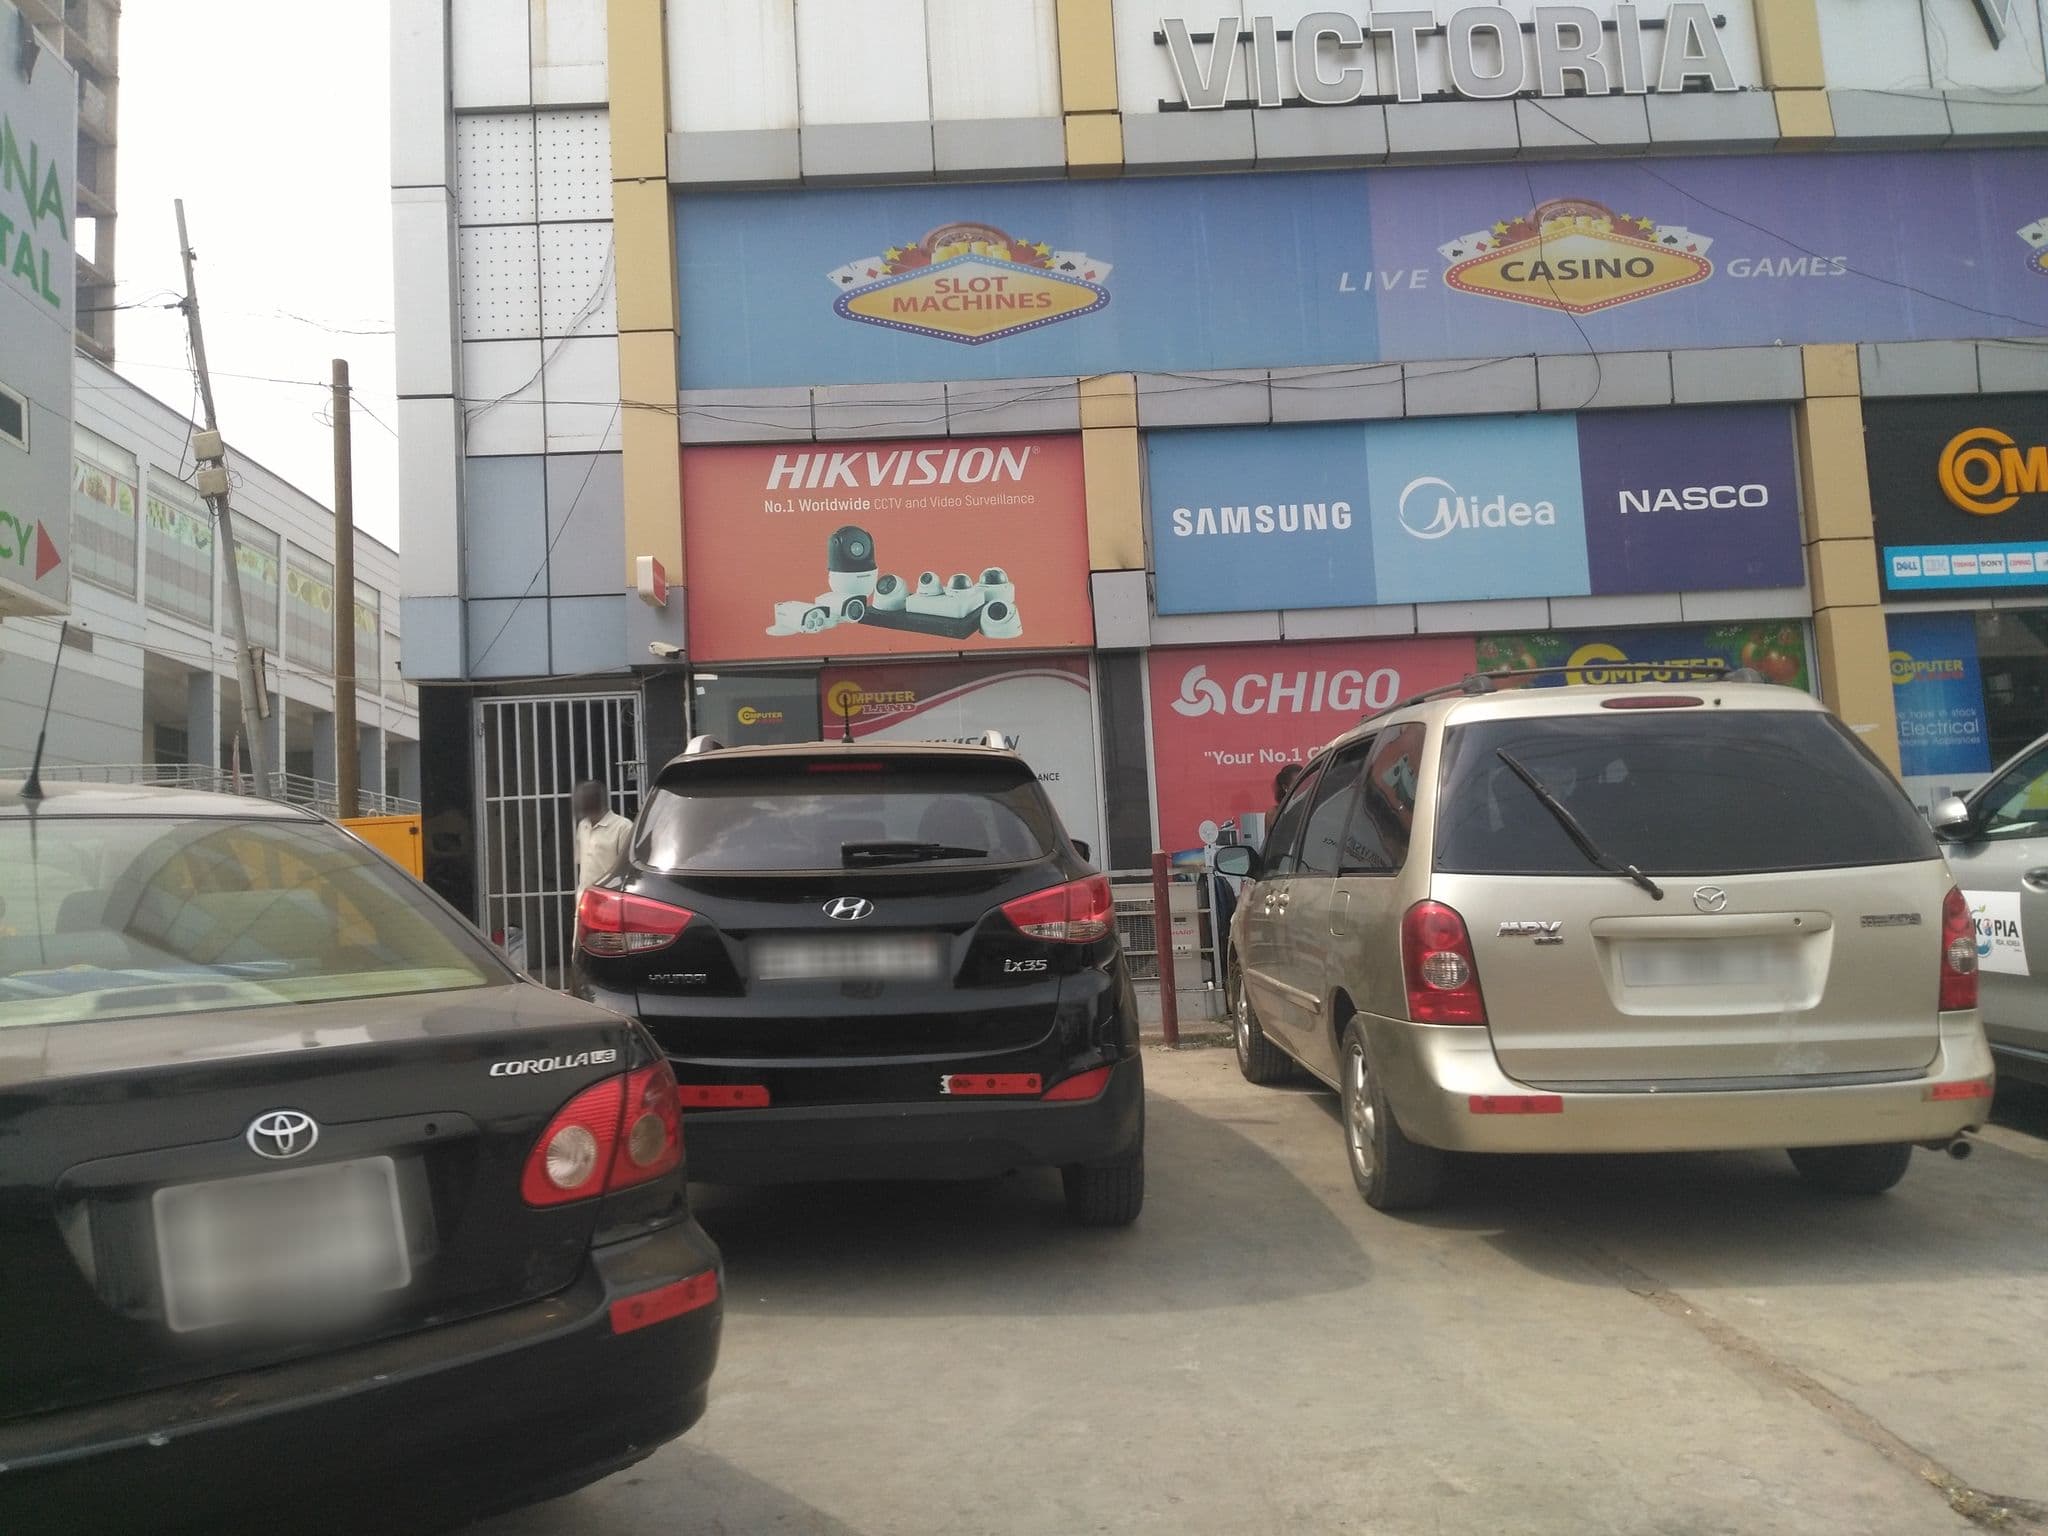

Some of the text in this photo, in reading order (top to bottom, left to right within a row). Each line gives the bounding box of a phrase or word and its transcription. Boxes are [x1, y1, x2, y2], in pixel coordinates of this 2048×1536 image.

[1161, 3, 1740, 110] VICTORIA
[0, 112, 68, 243] NA
[934, 276, 1008, 295] SLOT
[1339, 256, 1848, 292] LIVE CASINO GAMES
[892, 292, 1052, 314] MACHINES
[766, 446, 1030, 490] HIKVISION
[764, 492, 1035, 513] No.1 Worldwide CCTV and Video Surveillance
[1403, 480, 1555, 540] Midea
[1618, 484, 1769, 514] NASCO
[1172, 501, 1352, 537] SAMSUNG
[1888, 650, 1963, 684] COMPUTER
[828, 681, 915, 717] COMPUTER
[1231, 668, 1401, 715] CHIGO
[863, 703, 917, 714] LAND
[1901, 719, 1979, 737] Electrical
[1204, 750, 1254, 765] "Your
[1260, 747, 1302, 763] No.1
[648, 973, 707, 984] HYUNDAI
[1003, 958, 1048, 973] ix35
[490, 1052, 589, 1077] COROLLA
